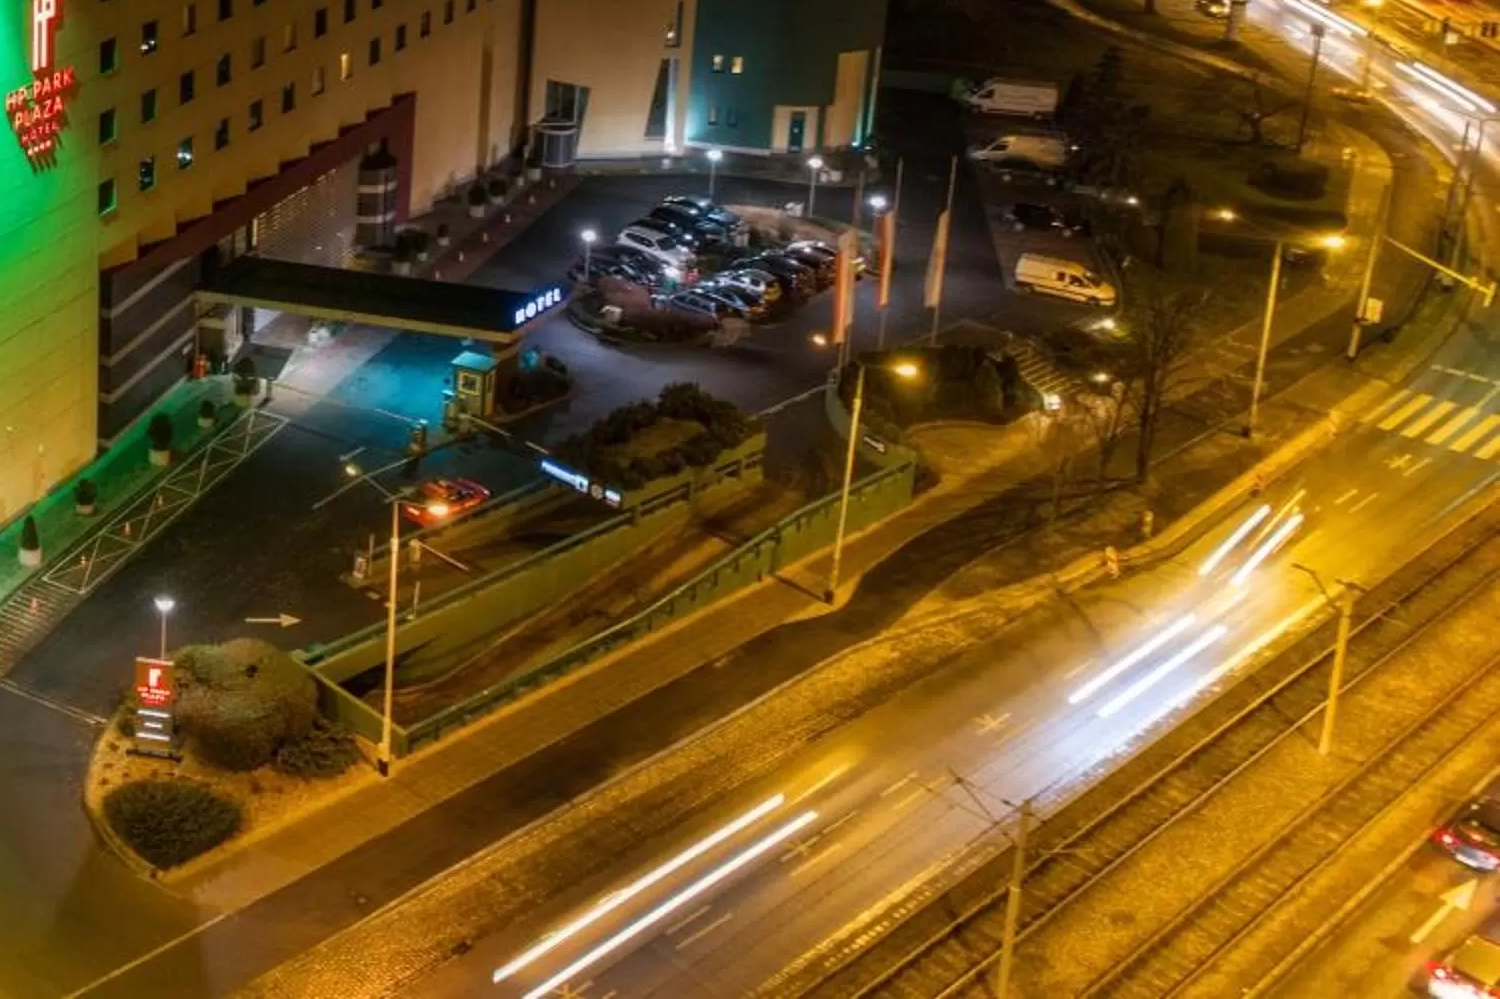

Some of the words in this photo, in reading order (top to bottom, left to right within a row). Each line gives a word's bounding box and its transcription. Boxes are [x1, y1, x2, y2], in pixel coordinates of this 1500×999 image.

[34, 65, 74, 99] PARK
[15, 96, 63, 130] PLAZA
[22, 121, 60, 143] HOTEL
